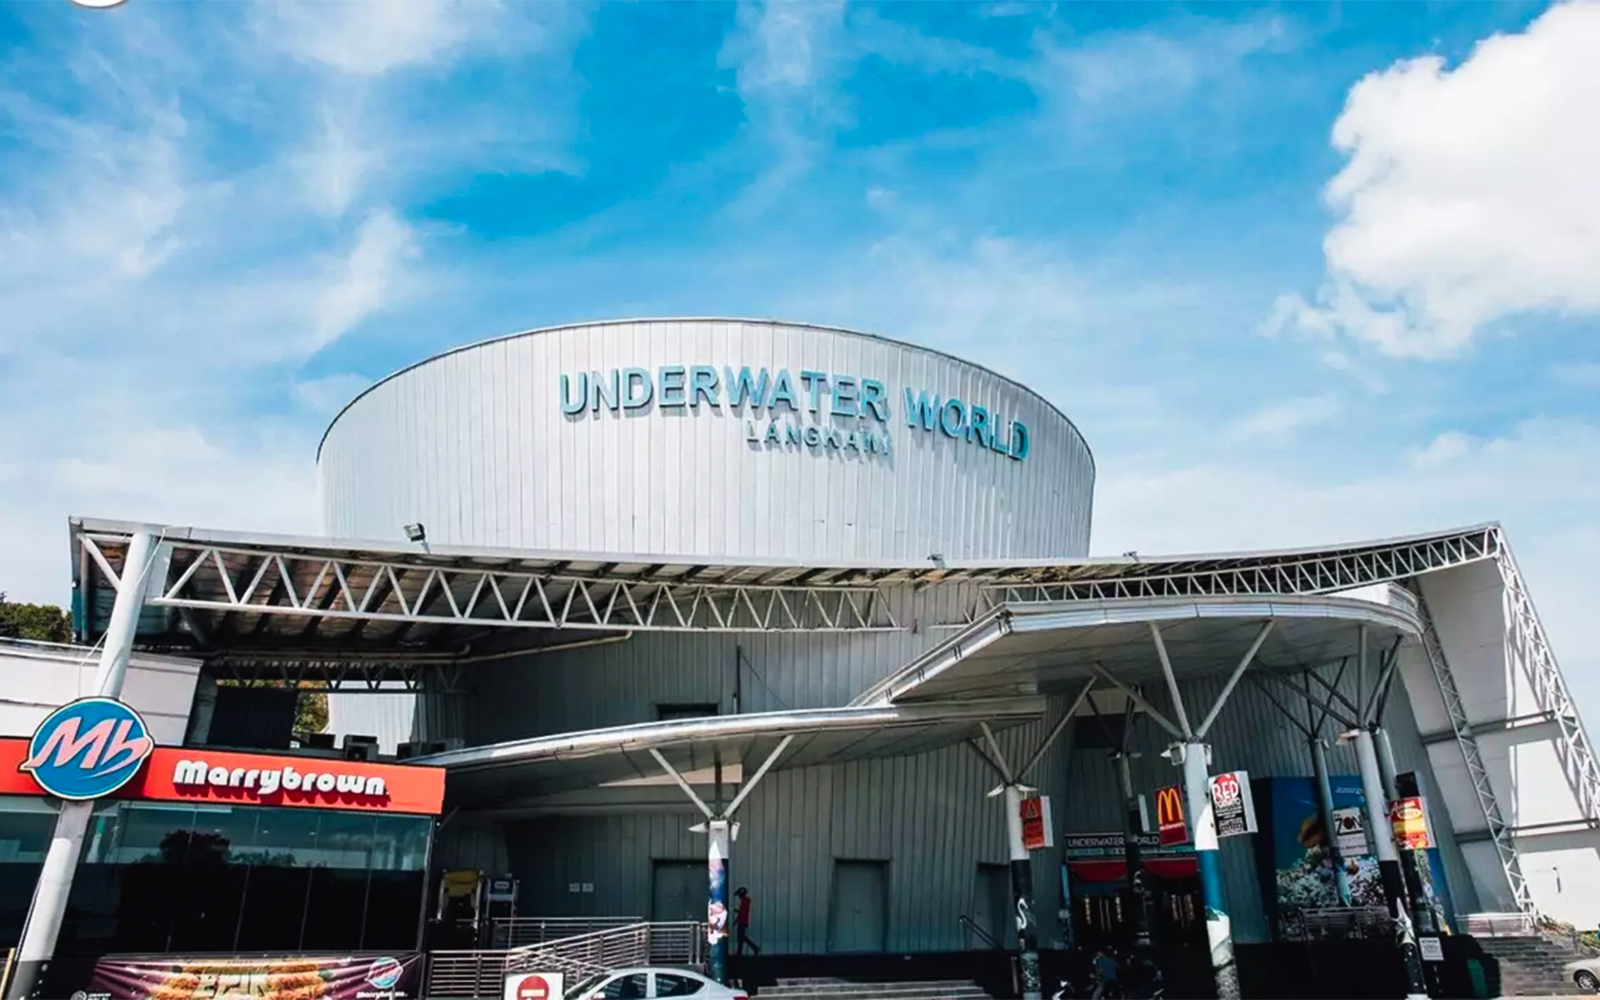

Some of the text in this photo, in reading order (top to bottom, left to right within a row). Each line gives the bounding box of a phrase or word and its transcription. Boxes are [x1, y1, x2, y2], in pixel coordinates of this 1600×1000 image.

[560, 365, 1030, 461] UNDERWATER WORLD
[747, 420, 889, 456] LANGKAWI
[1212, 780, 1239, 804] RED
[1067, 835, 1160, 847] UNDERWATER ORLD
